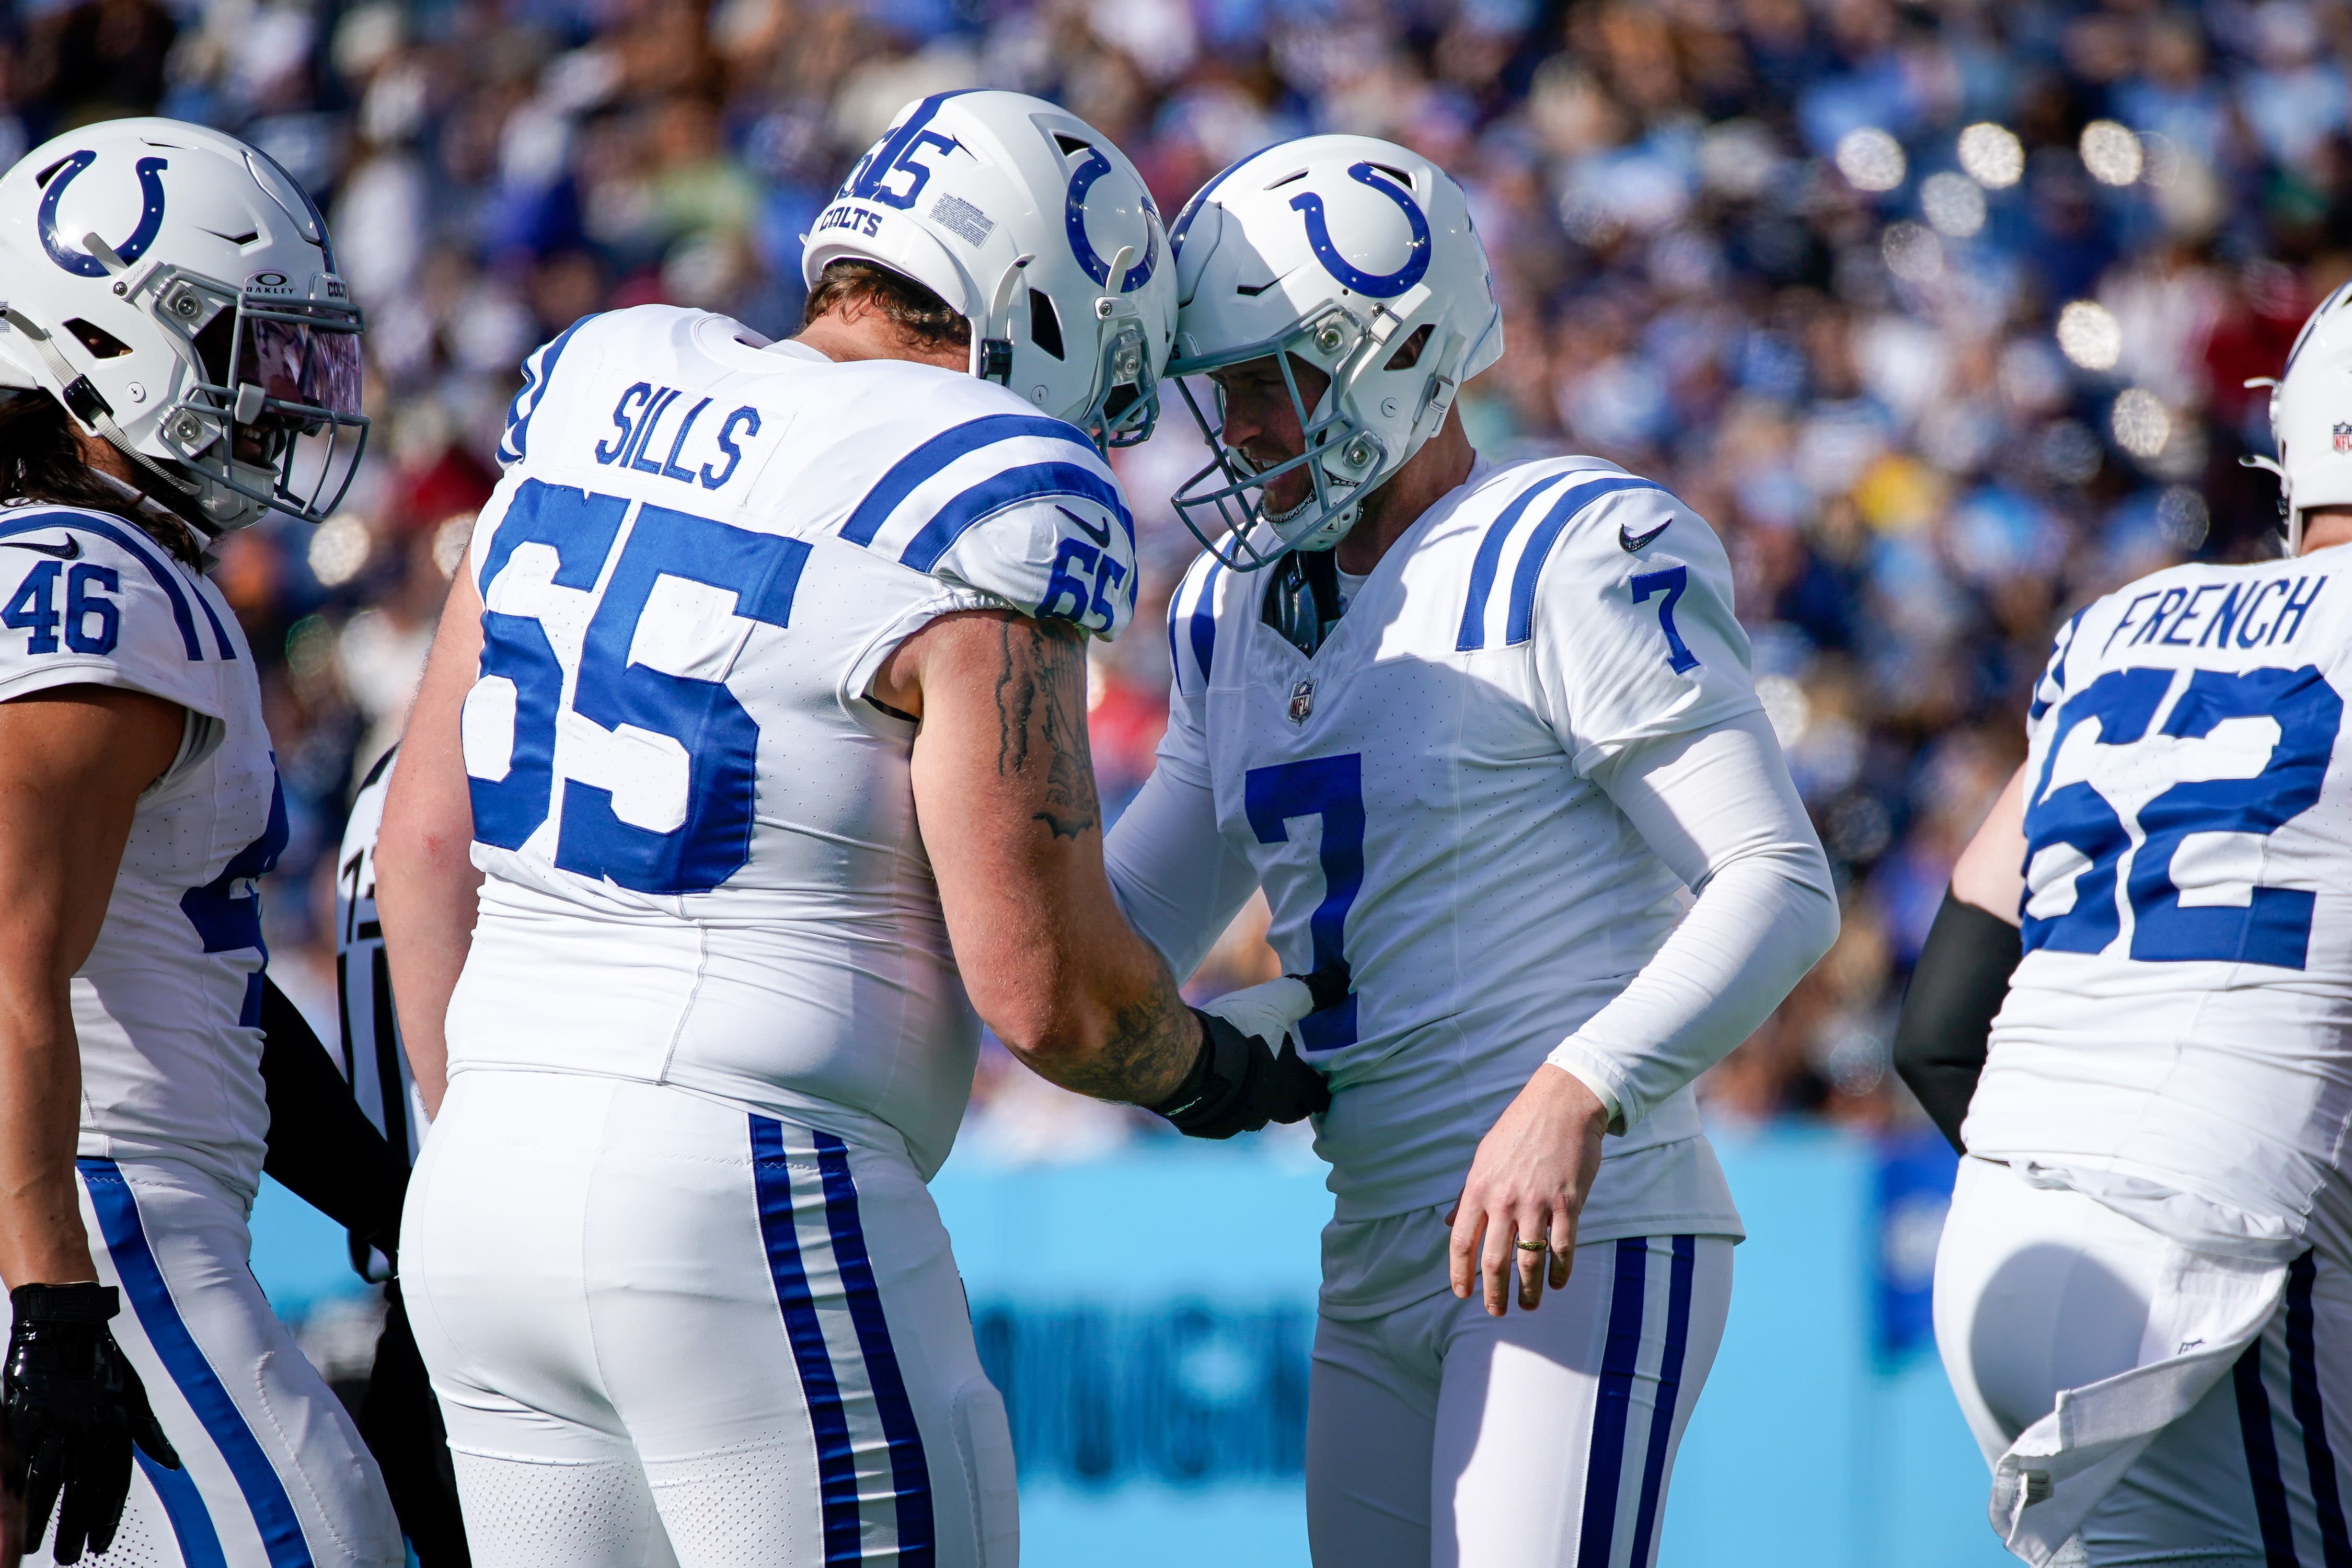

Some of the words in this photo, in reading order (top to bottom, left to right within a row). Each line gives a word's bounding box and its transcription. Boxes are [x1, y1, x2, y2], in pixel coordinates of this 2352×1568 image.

[836, 126, 959, 211] 65
[958, 197, 984, 215] WARNING
[818, 206, 883, 238] COLTS
[595, 381, 761, 490] SILLS
[0, 560, 120, 655] 46
[1034, 536, 1127, 633] 65
[1631, 565, 1701, 676] 7
[2101, 575, 2328, 659] FRENCH
[462, 477, 813, 895] 65
[1291, 696, 1309, 716] NFL
[2020, 664, 2344, 971] 62
[1244, 752, 1366, 1052] 7
